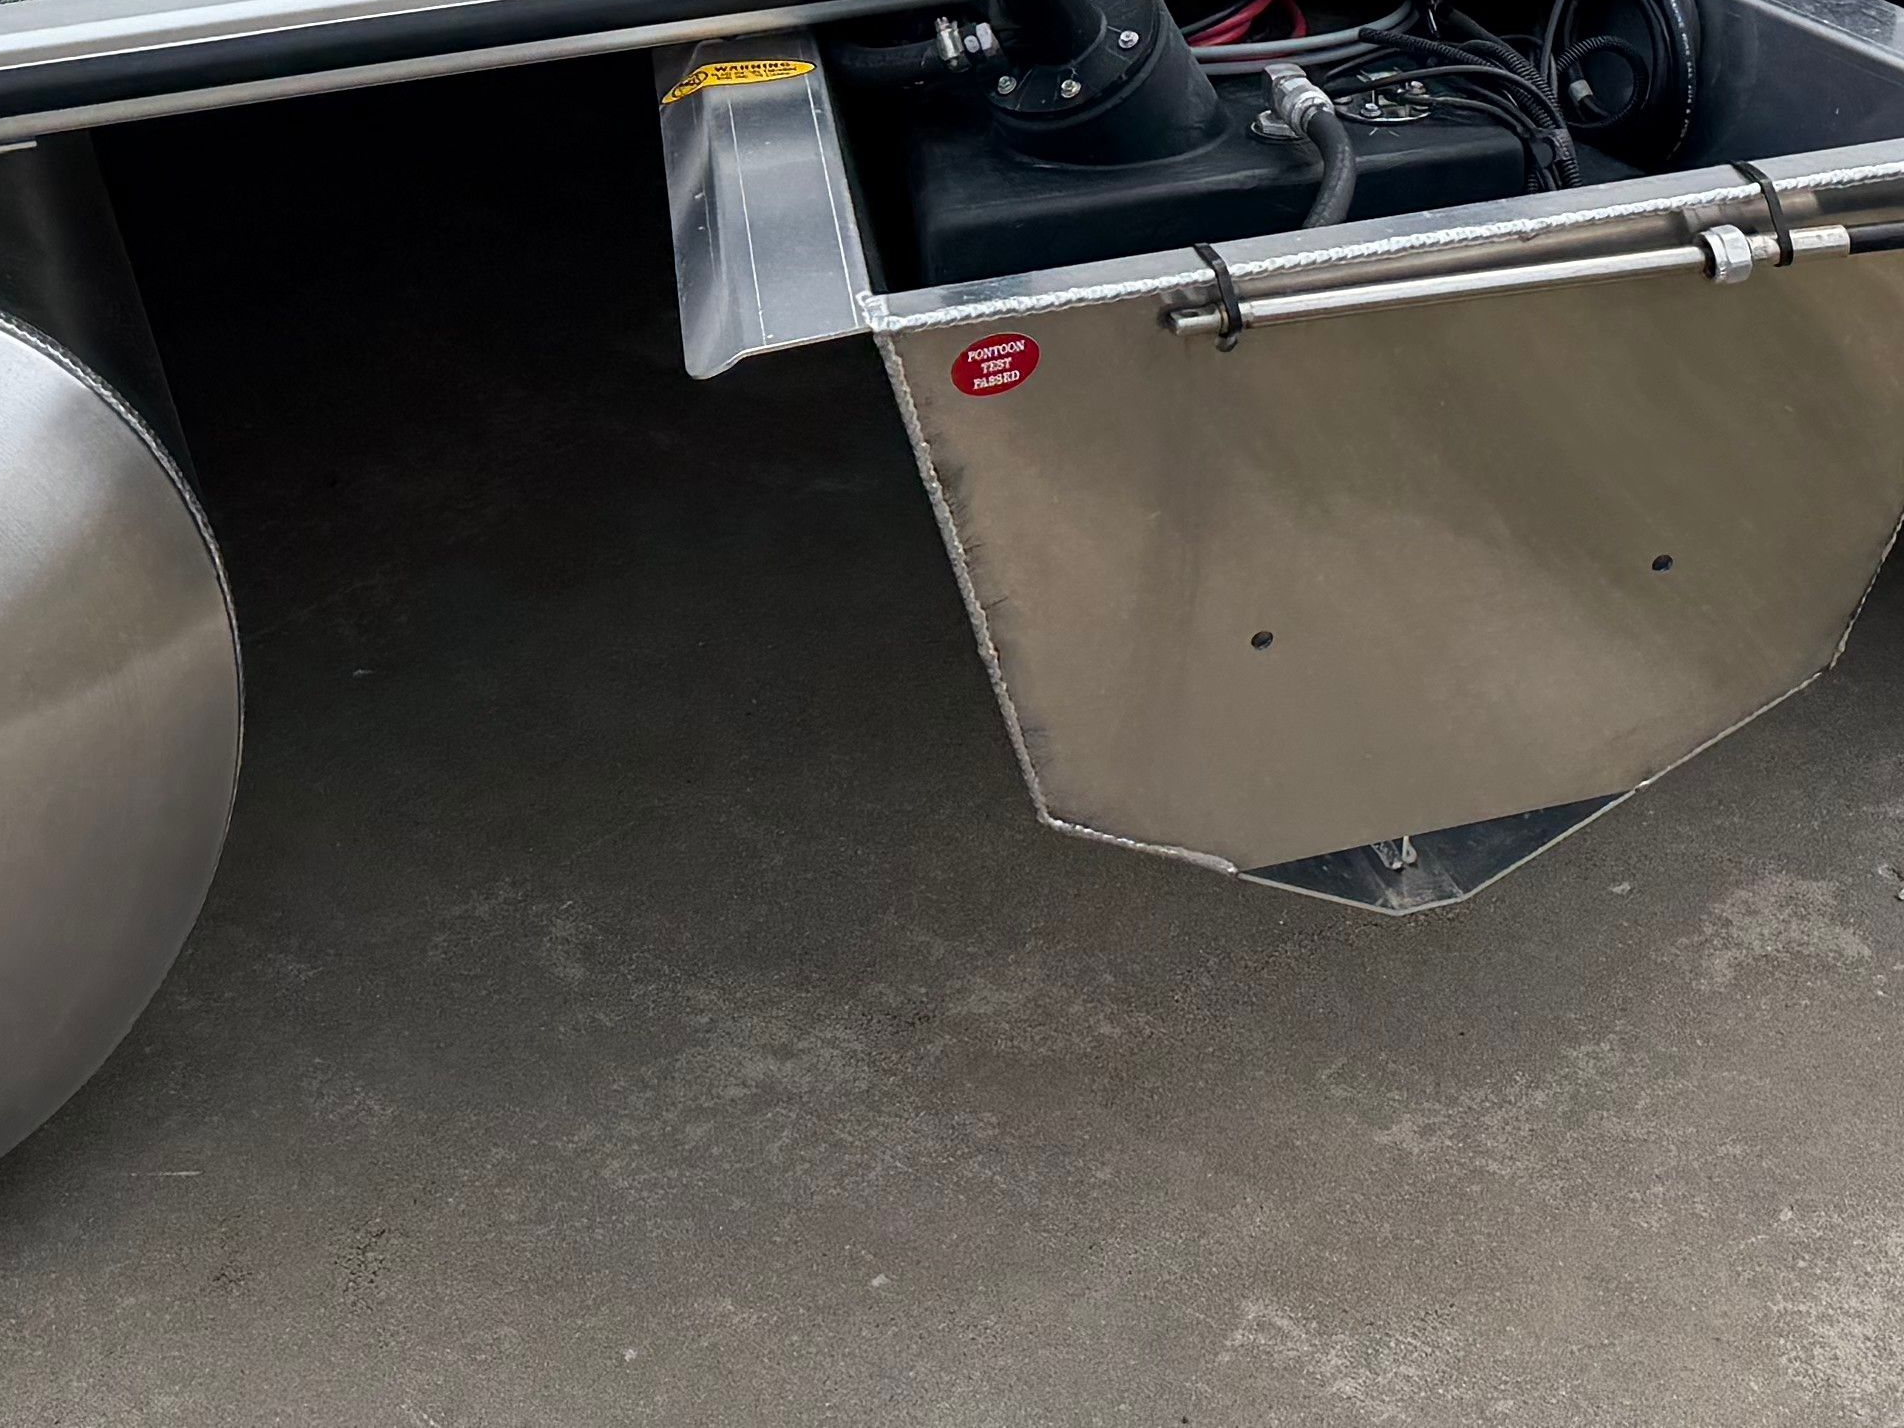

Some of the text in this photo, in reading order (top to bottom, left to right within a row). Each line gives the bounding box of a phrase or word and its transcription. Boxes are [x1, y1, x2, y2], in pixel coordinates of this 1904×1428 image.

[967, 339, 1026, 363] PONTOON
[980, 356, 1013, 375] TEST
[973, 369, 1021, 390] PASSED
